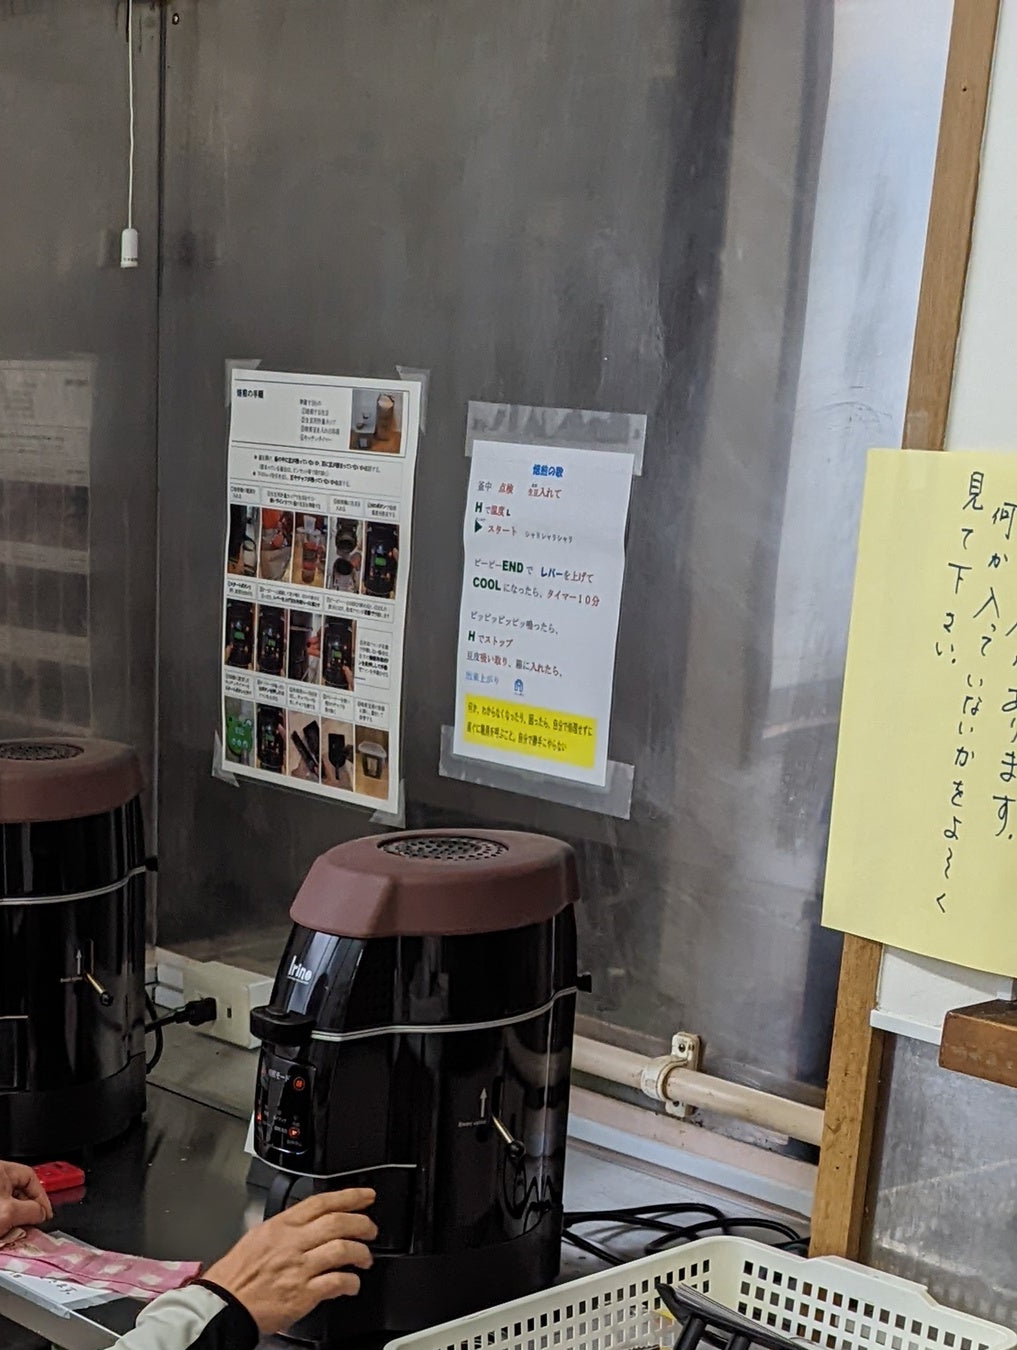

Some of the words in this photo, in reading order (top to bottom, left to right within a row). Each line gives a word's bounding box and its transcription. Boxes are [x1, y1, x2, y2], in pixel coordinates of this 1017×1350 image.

[498, 483, 514, 495] 点検
[488, 524, 517, 536] スタート
